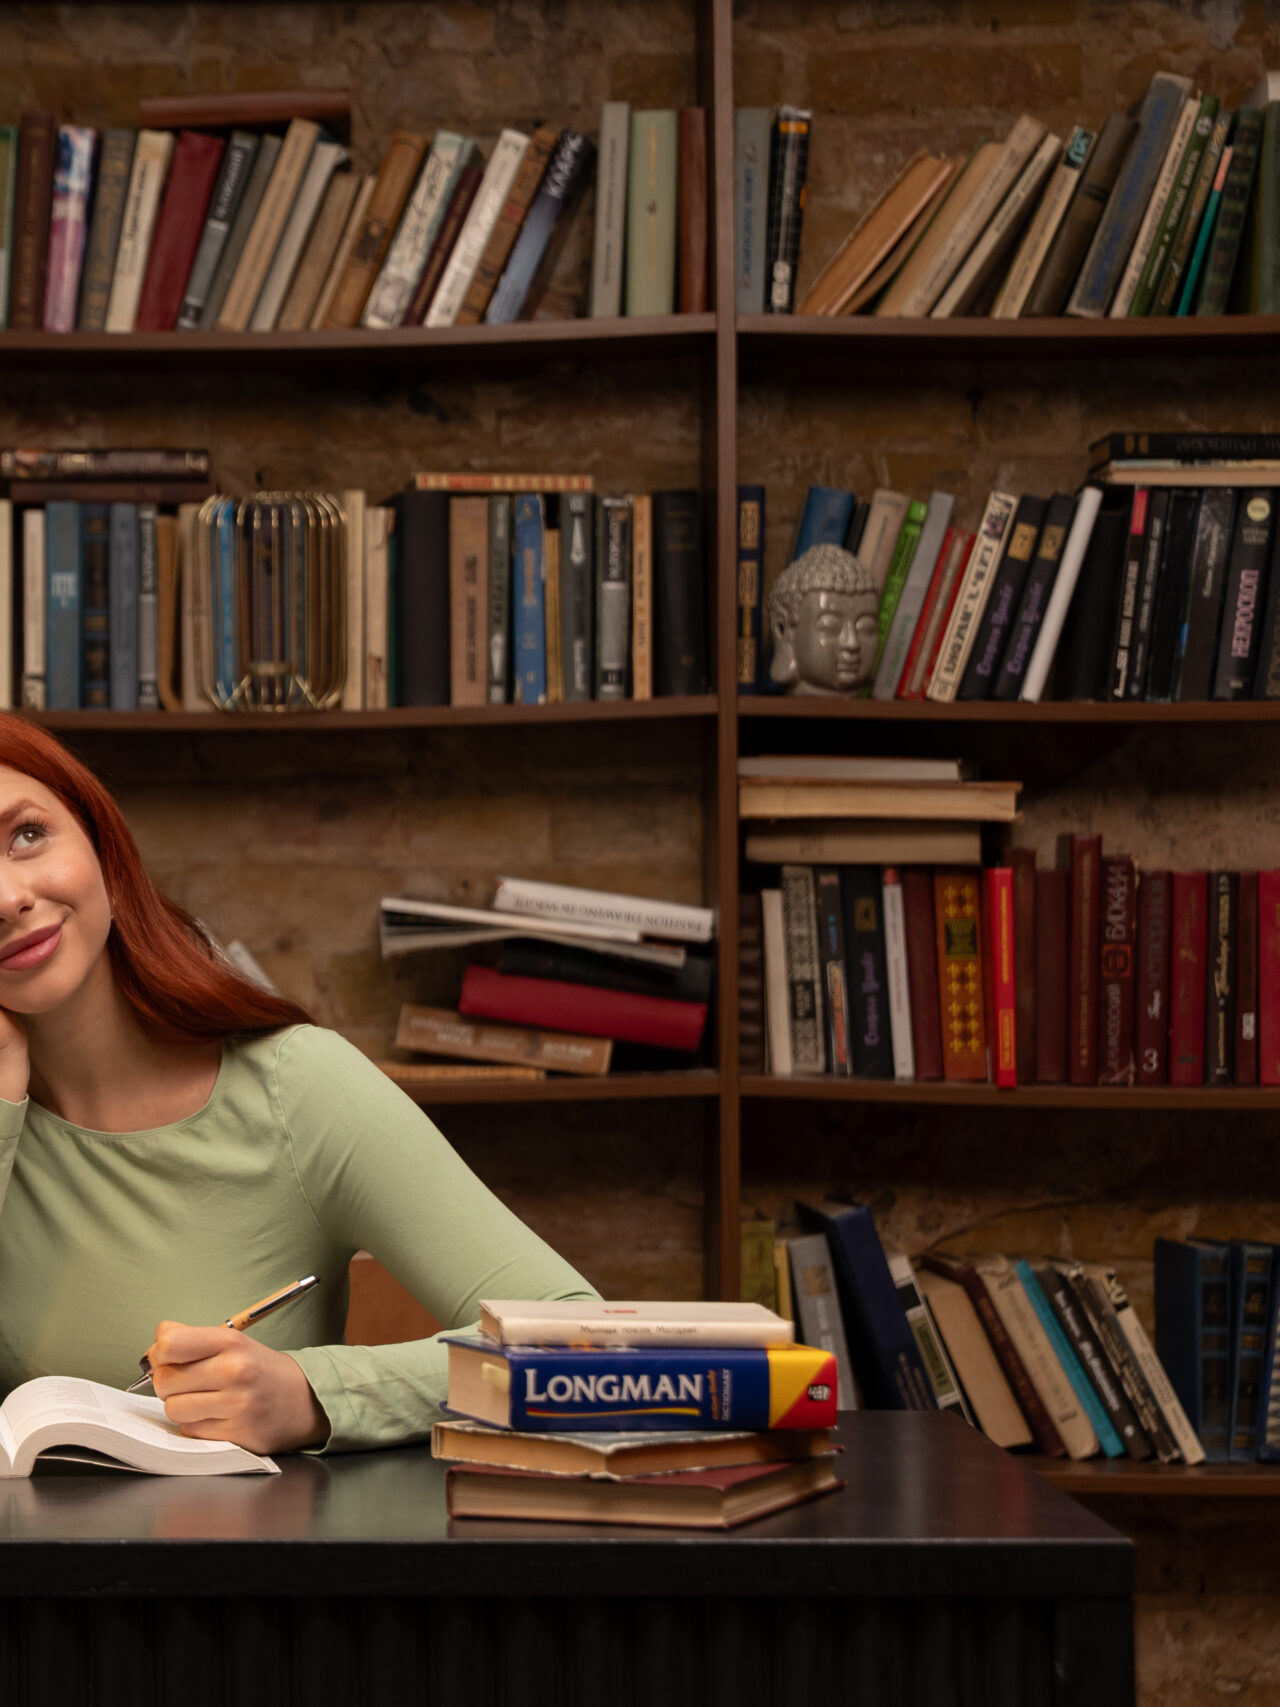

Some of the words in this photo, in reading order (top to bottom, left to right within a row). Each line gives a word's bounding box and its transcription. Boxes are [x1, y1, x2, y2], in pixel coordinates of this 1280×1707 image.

[560, 903, 576, 915] IN
[579, 905, 642, 923] DRAWING
[646, 915, 702, 932] FASHION
[1142, 1047, 1158, 1073] 3
[523, 1368, 703, 1403] LONGMAN
[722, 1368, 731, 1421] DICTIONARY
